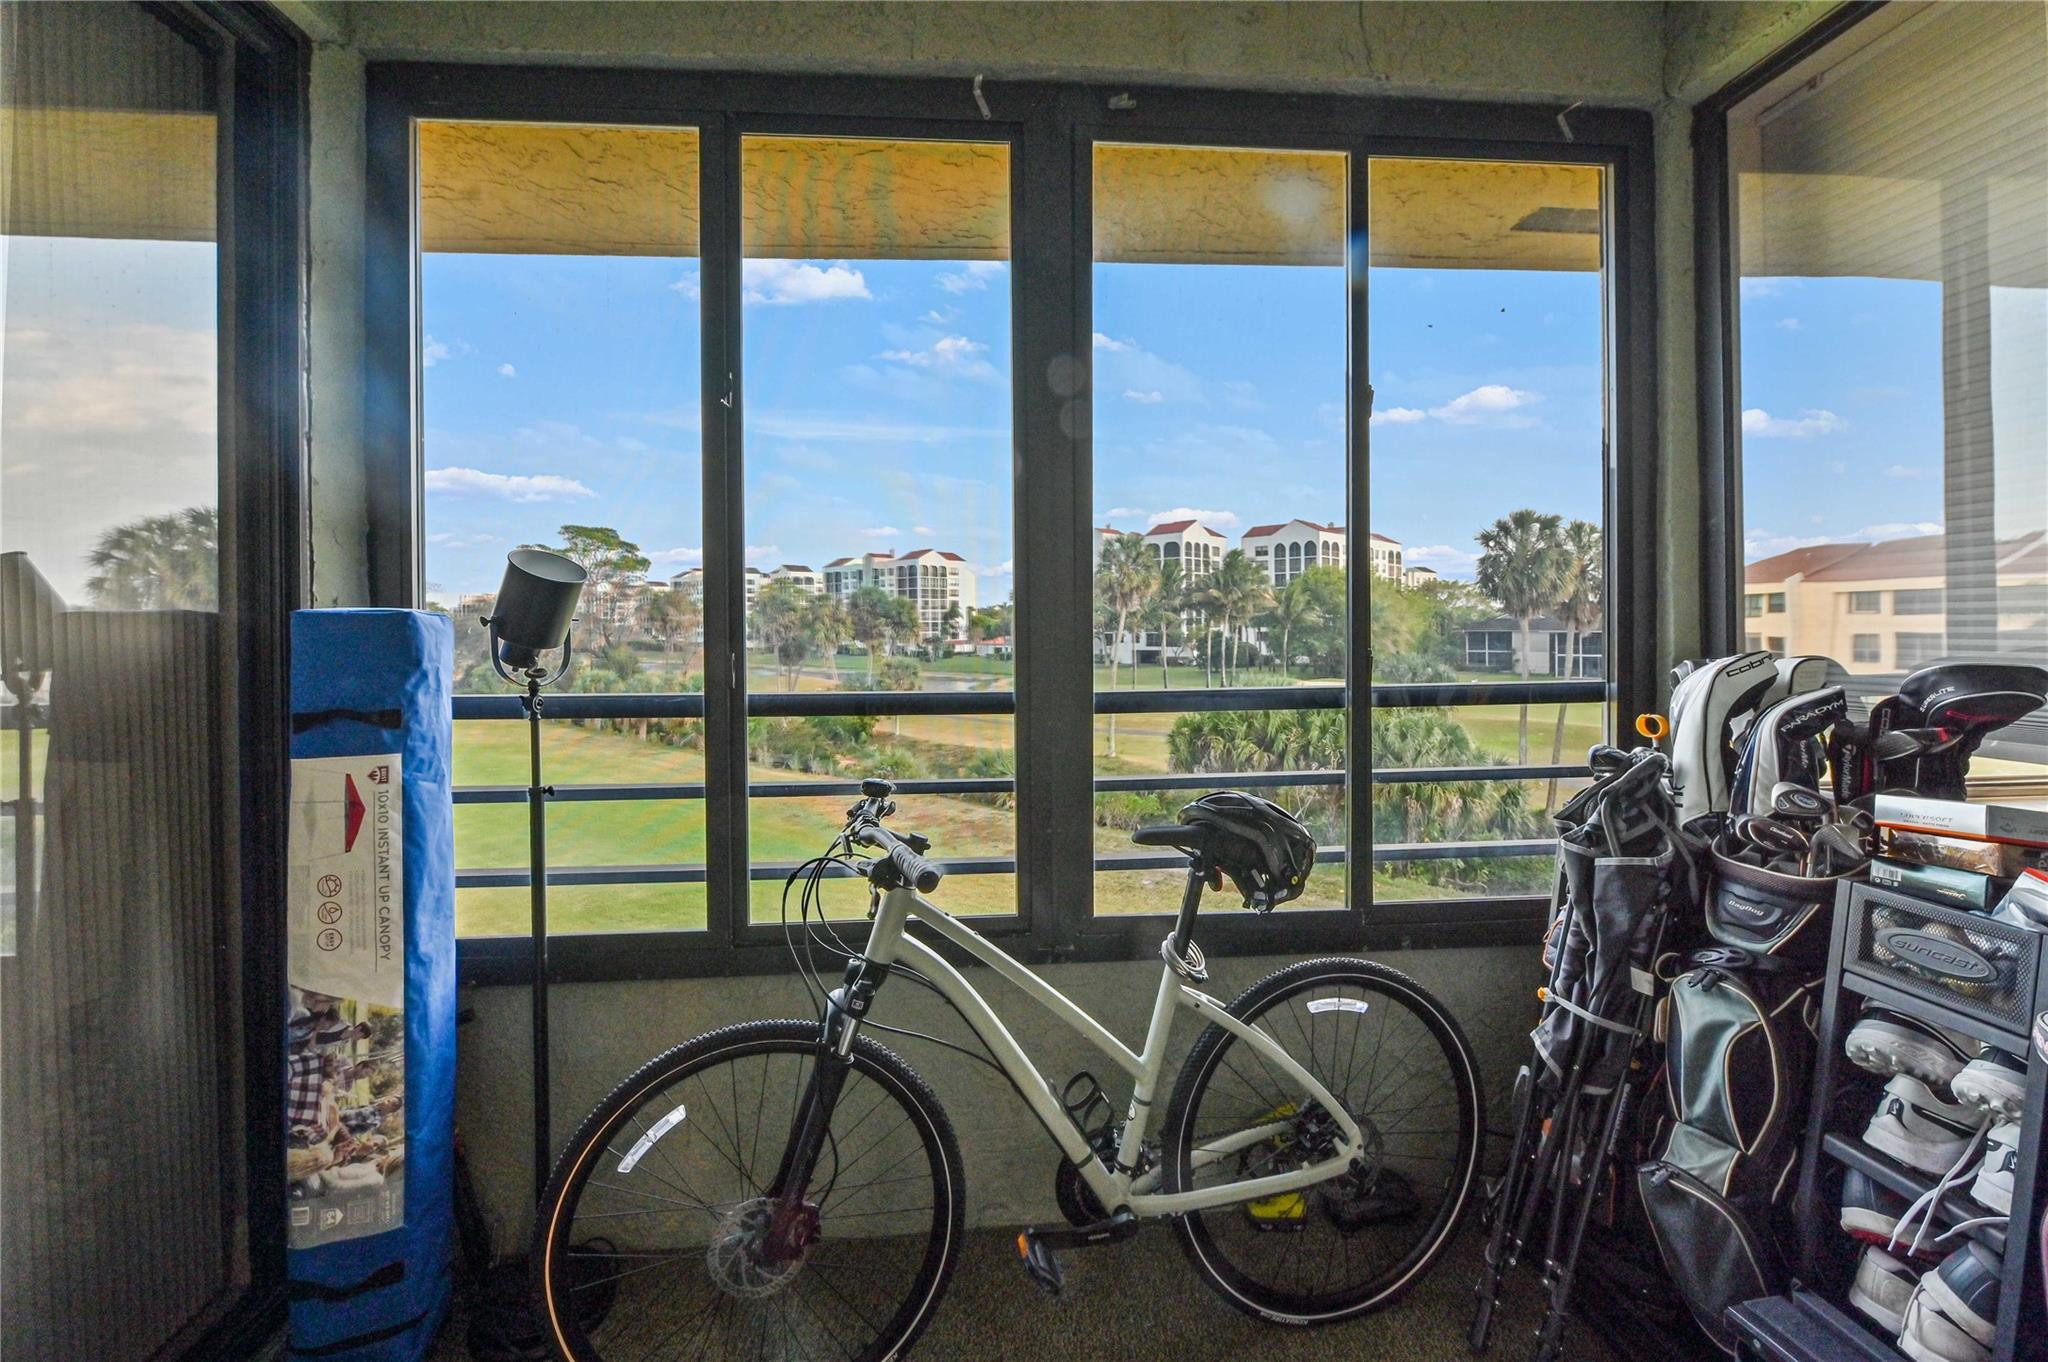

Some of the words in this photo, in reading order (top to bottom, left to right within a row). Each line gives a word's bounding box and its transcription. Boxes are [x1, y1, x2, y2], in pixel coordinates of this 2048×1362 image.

[1919, 686, 1955, 713] SUPERLITE
[1780, 699, 1845, 733] PARADYM
[1841, 744, 1857, 799] TaylorMade
[377, 827, 390, 881] INSTANT
[378, 885, 390, 903] UP
[1728, 900, 1765, 916] BagBoy
[379, 906, 391, 960] CANOPY
[1894, 940, 1978, 970] suncast
